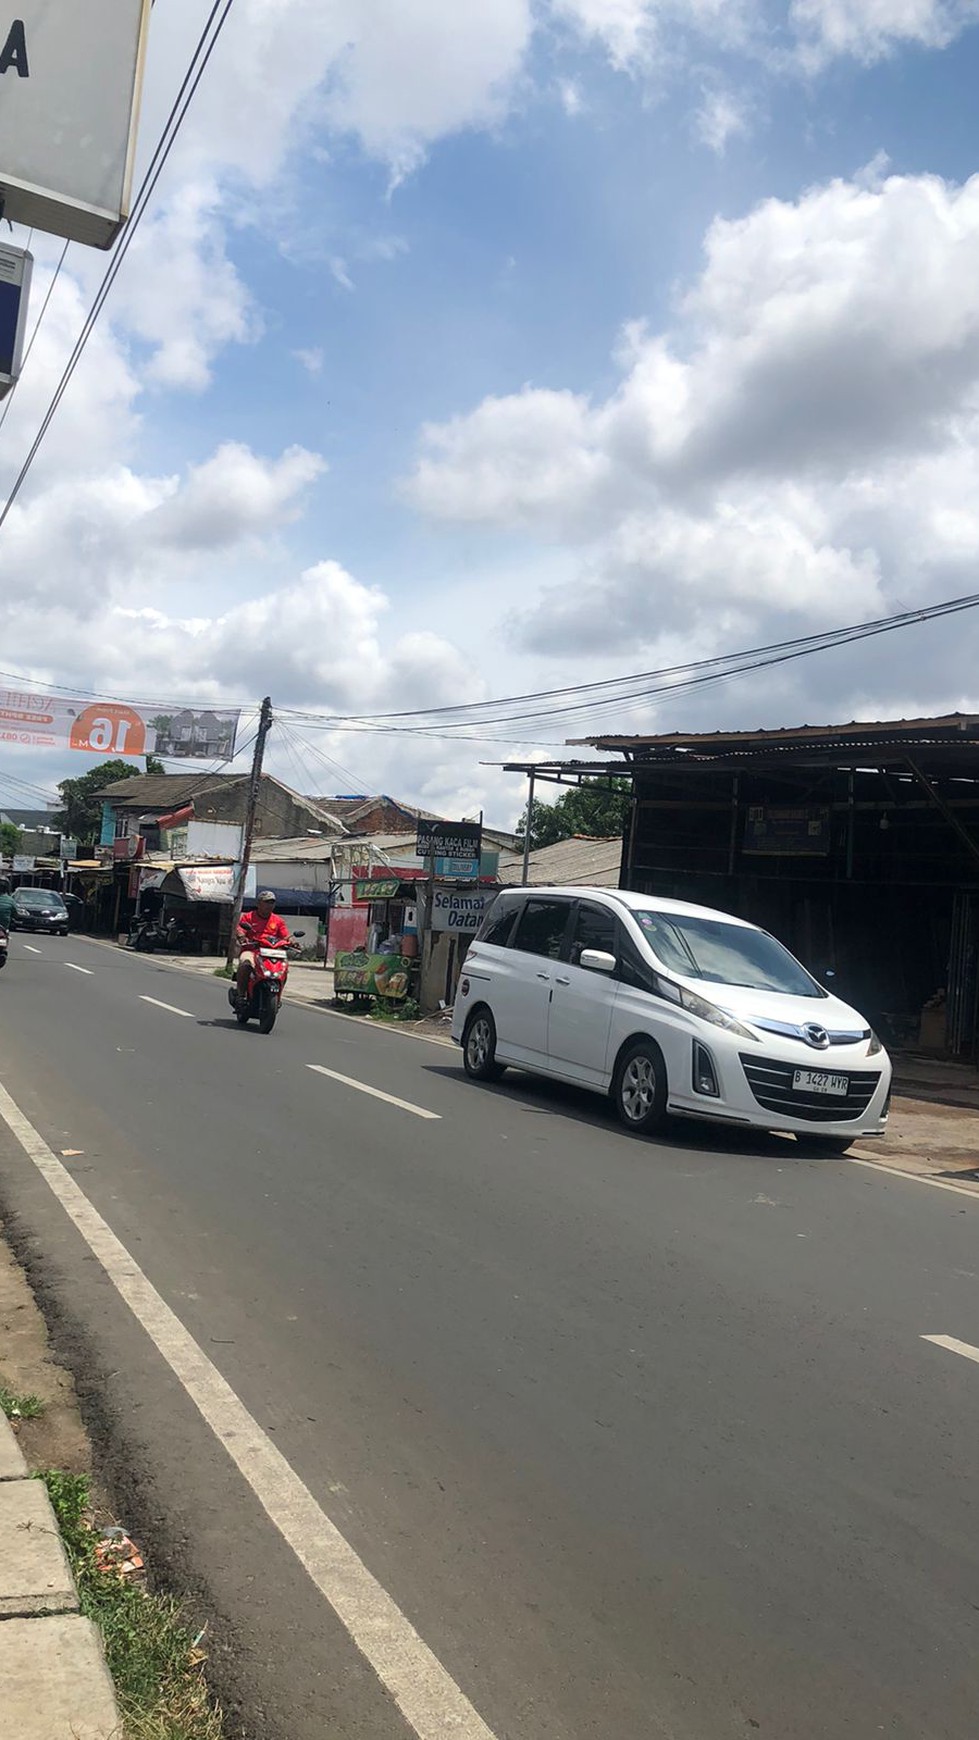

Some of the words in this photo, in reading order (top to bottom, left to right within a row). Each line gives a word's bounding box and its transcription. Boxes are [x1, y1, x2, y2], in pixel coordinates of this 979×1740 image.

[444, 836, 462, 847] KACA
[463, 838, 479, 849] FILM
[447, 850, 477, 859] STICKER
[434, 892, 485, 910] Selamat
[447, 910, 484, 928] Datan
[795, 1071, 802, 1083] B
[806, 1072, 829, 1087] 1427
[830, 1076, 847, 1091] WYR
